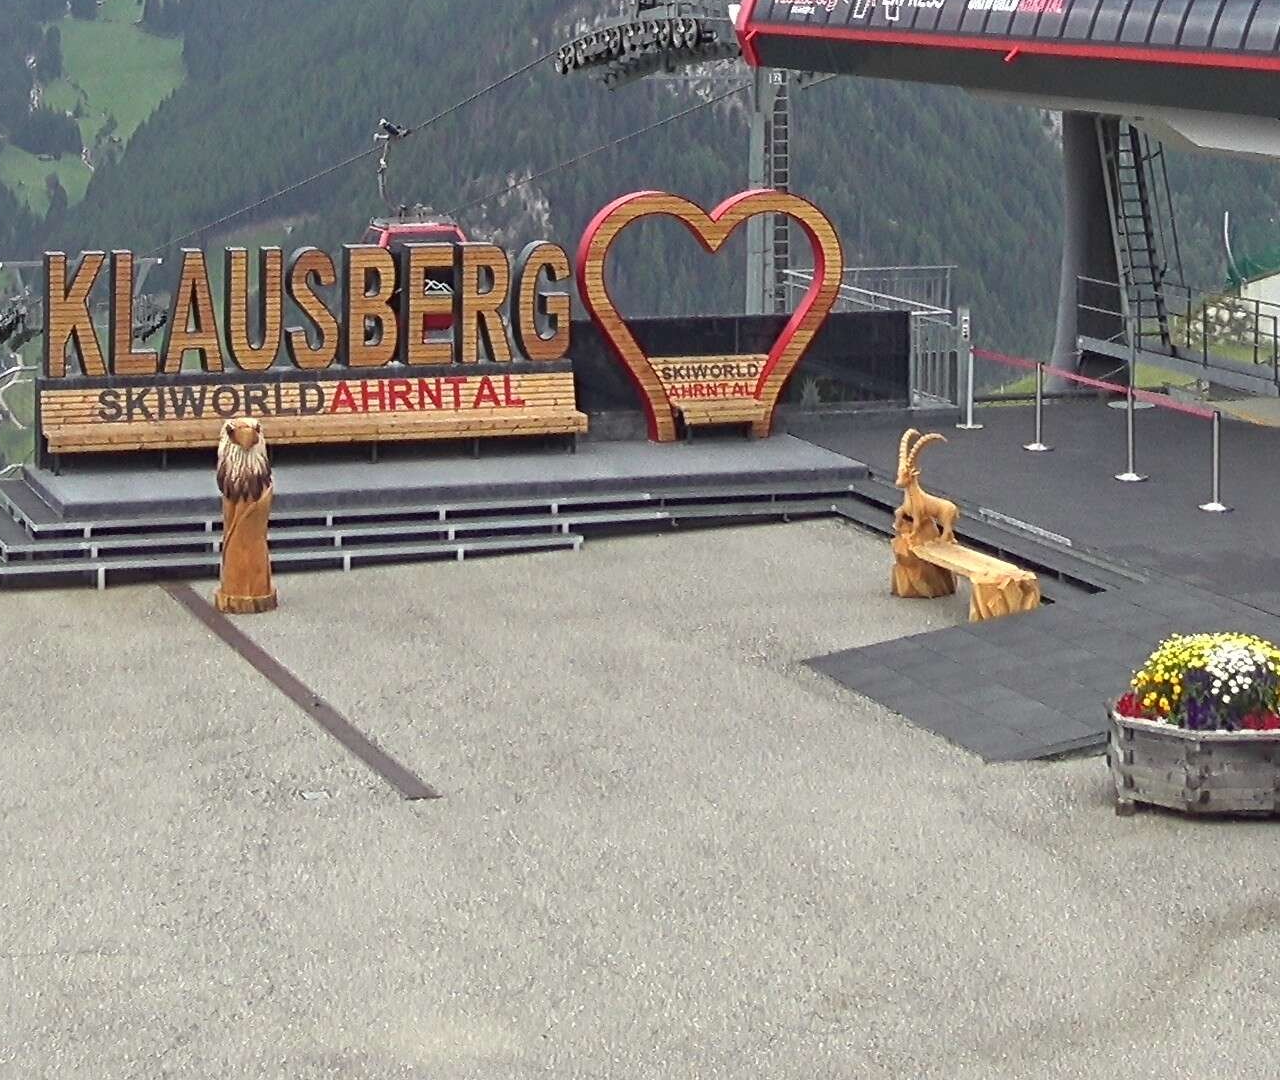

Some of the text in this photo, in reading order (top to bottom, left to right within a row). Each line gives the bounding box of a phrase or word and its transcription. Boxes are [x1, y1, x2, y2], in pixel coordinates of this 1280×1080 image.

[43, 240, 572, 378] KLAUSBERG
[661, 363, 759, 381] SKIWORLD
[668, 381, 756, 398] AHRNTAL
